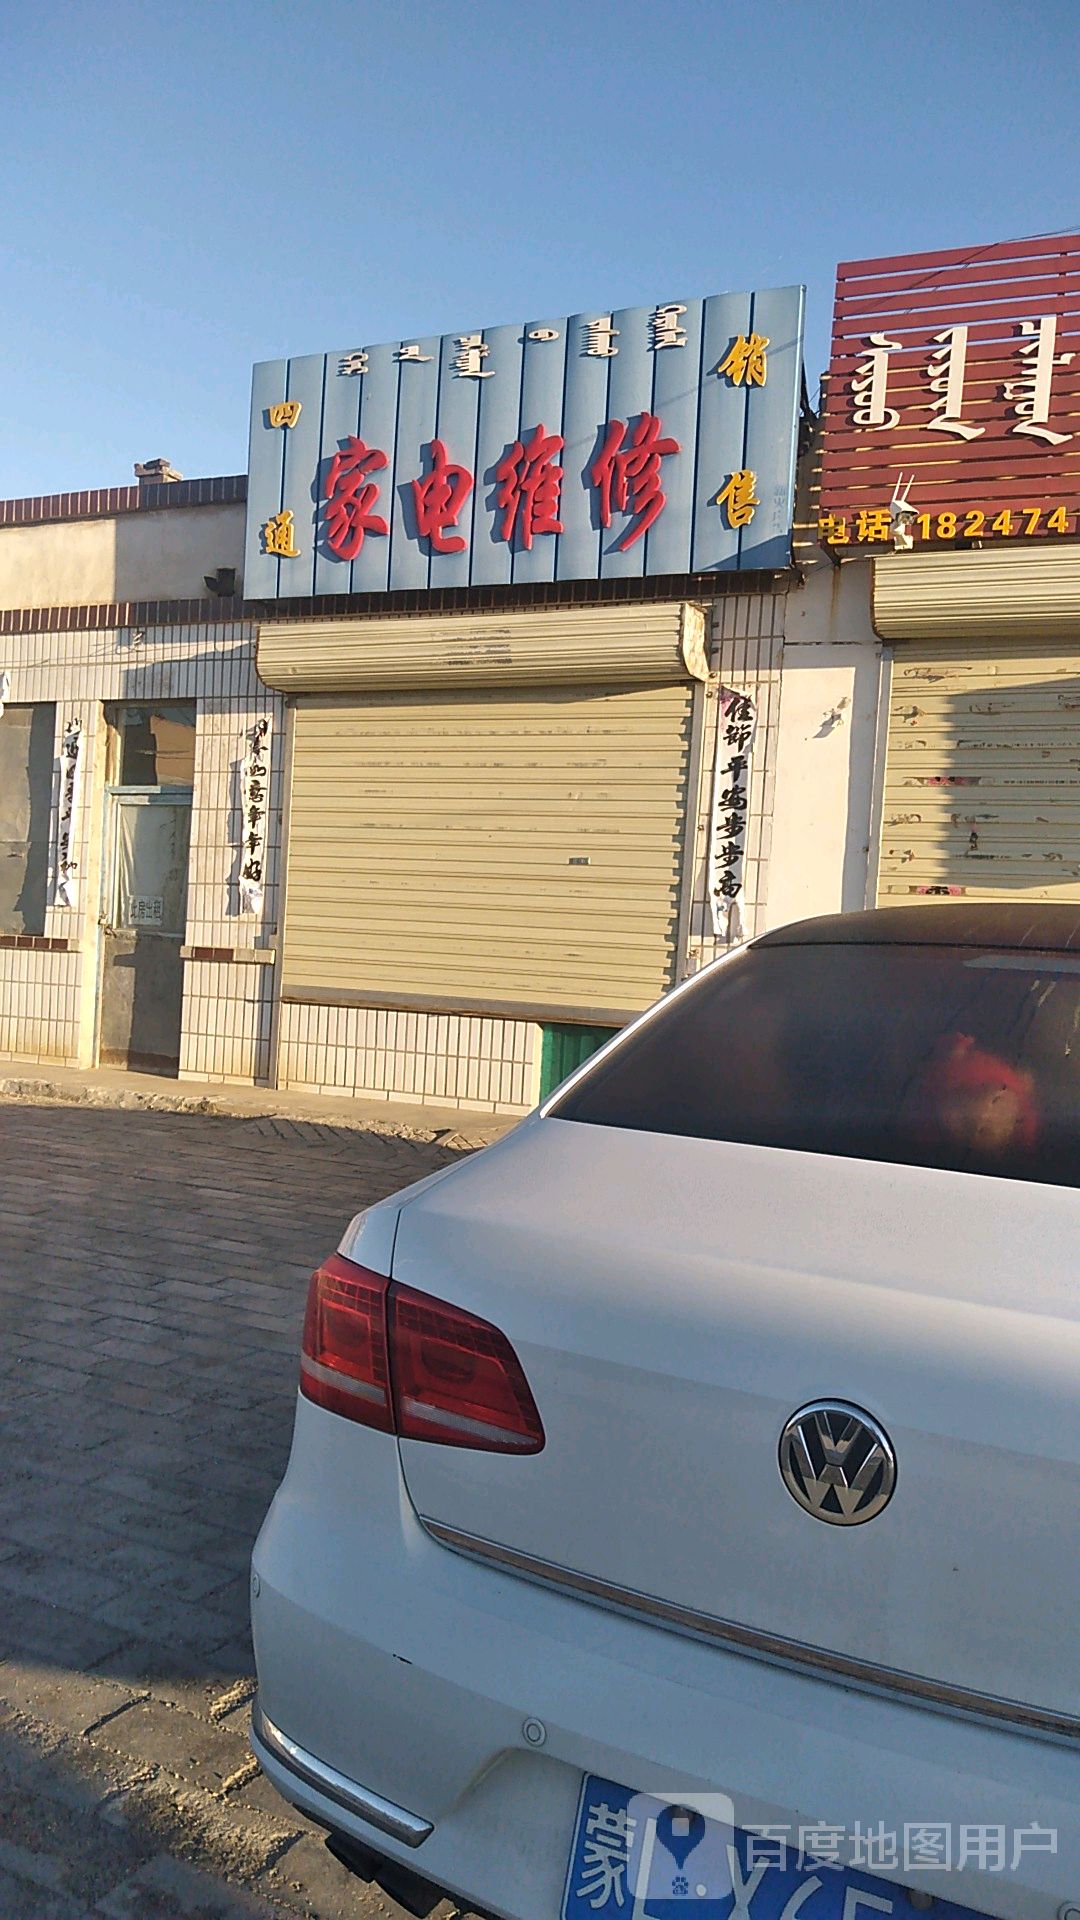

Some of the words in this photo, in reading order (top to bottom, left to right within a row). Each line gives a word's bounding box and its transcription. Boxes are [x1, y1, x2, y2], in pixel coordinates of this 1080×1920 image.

[266, 401, 302, 558] 四通
[323, 411, 681, 562] 家电维修
[717, 333, 770, 529] 销售
[818, 508, 892, 544] 电话
[916, 506, 1069, 540] 182474
